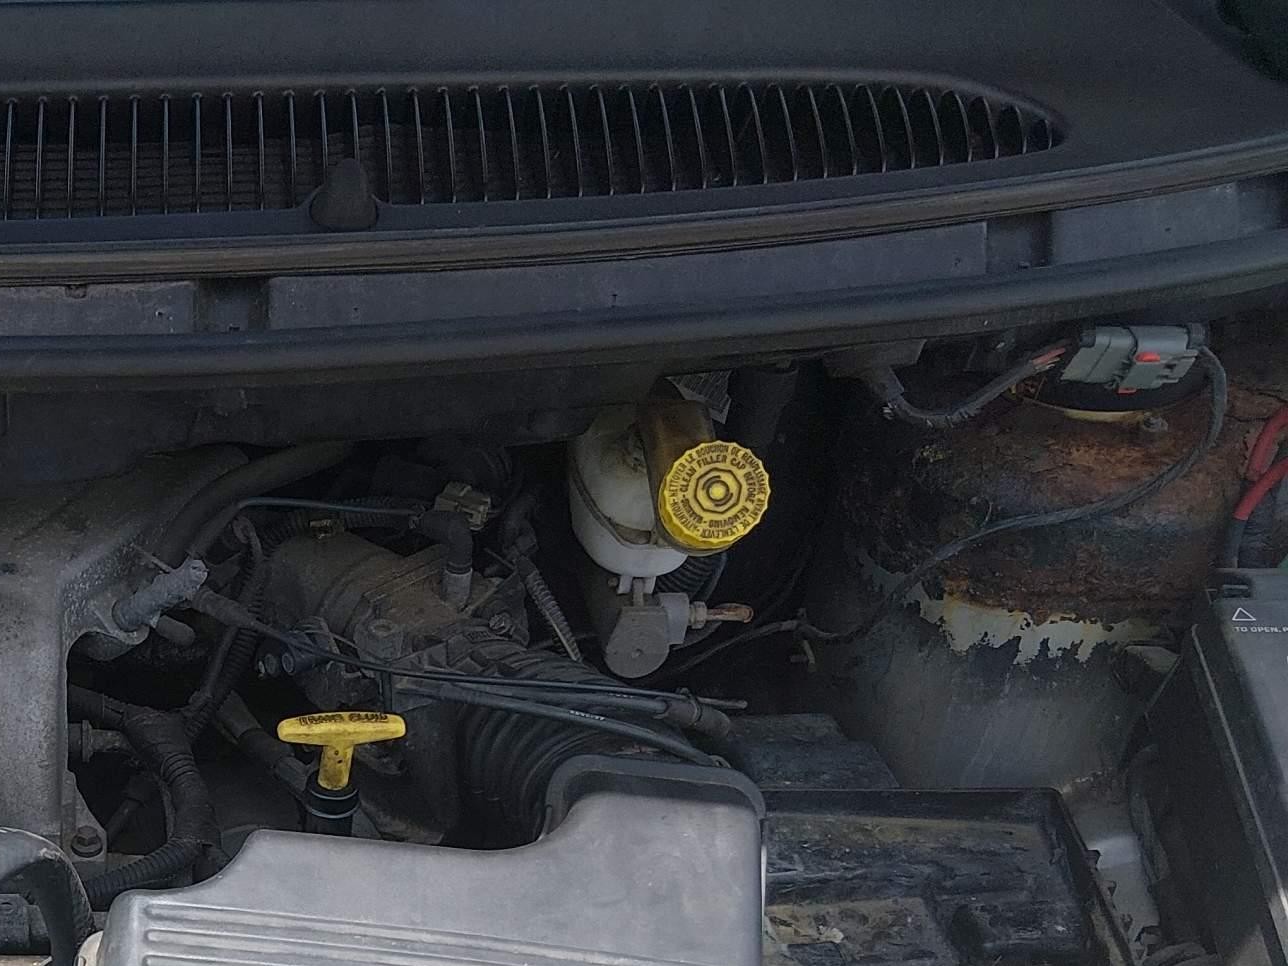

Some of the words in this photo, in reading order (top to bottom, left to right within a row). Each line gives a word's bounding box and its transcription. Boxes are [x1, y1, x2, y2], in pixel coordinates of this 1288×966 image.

[669, 463, 686, 497] NETTOYER
[696, 444, 729, 456] BOUCHON
[696, 454, 728, 469] FILLER
[730, 458, 746, 470] CAP
[679, 466, 697, 493] CLEAN
[743, 471, 757, 503] BEFORE
[680, 498, 704, 524] WARNING
[708, 505, 750, 528] REMOVING
[348, 712, 388, 723] FLUID
